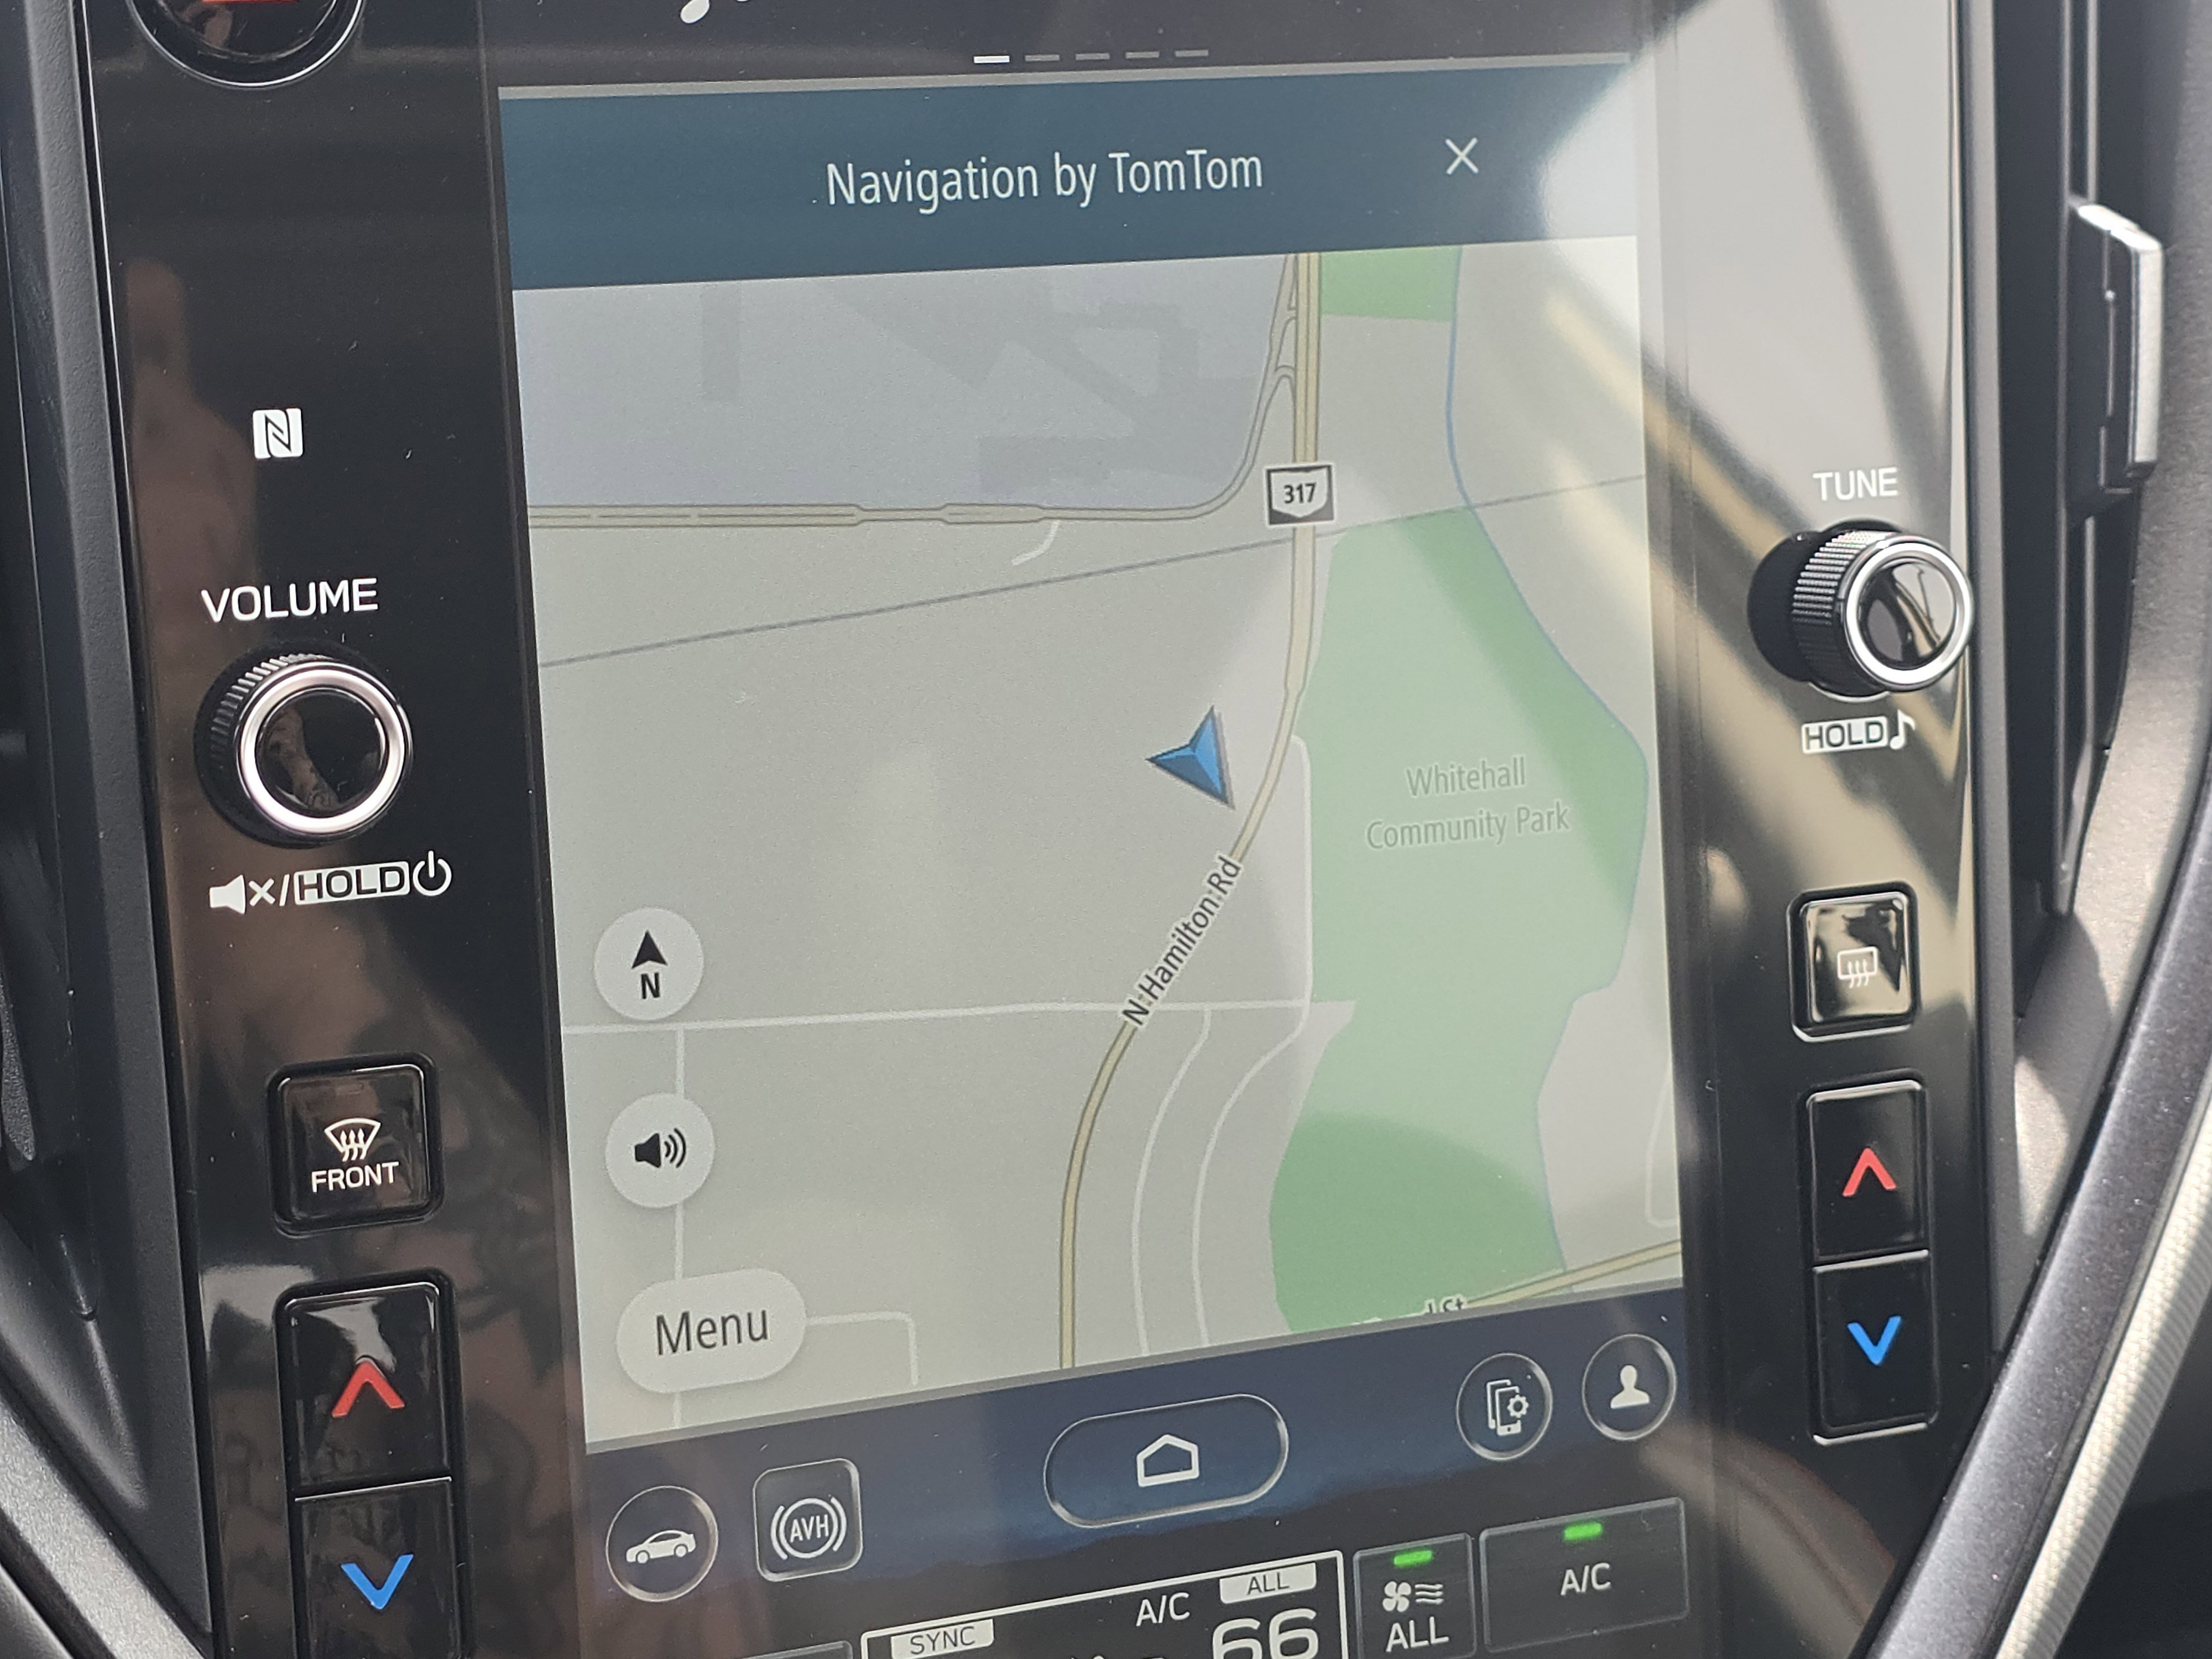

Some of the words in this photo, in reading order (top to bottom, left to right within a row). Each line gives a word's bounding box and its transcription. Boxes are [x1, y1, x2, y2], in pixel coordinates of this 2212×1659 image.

[826, 155, 1039, 215] Navigation
[1053, 152, 1097, 207] by
[1107, 147, 1264, 195] TomTom
[1283, 482, 1316, 504] 317
[1812, 467, 1898, 501] TUNE
[201, 577, 378, 623] VOLUME
[1804, 722, 1885, 750] HOLD
[1406, 756, 1525, 796] Whitehall
[1367, 810, 1506, 849] Community
[1516, 801, 1569, 834] Park
[1122, 999, 1150, 1026] N
[1138, 895, 1220, 1000] Hamilton
[1207, 855, 1241, 895] Rd
[640, 972, 660, 999] N
[311, 1161, 399, 1193] FRONT
[656, 1310, 768, 1356] Menu
[790, 1514, 829, 1543] AVH
[1246, 1572, 1290, 1595] ALL
[1561, 1562, 1611, 1596] A/C
[1136, 1592, 1191, 1627] A/C
[910, 1626, 975, 1655] SYNC
[1212, 1608, 1319, 1659] 66
[1385, 1616, 1449, 1652] ALL
